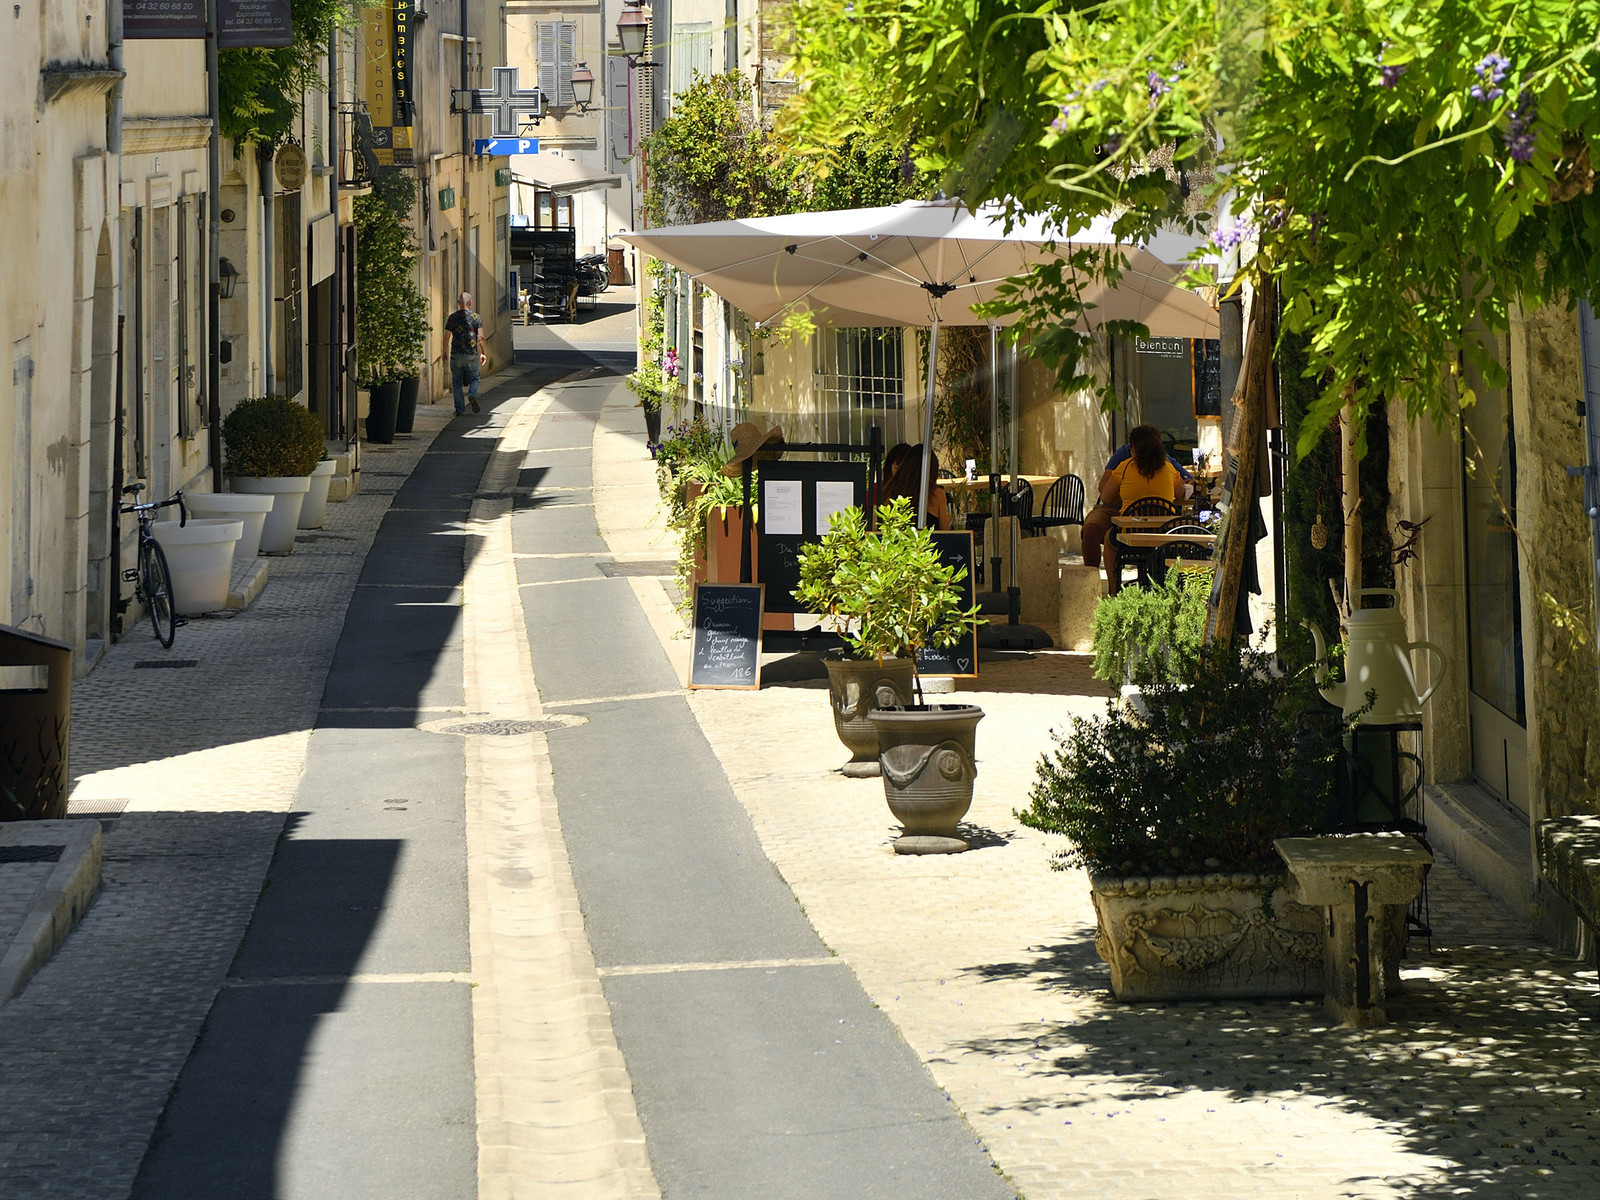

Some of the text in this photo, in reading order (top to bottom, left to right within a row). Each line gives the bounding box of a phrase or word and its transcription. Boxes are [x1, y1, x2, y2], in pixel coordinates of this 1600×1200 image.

[136, 2, 146, 10] 04
[147, 2, 158, 10] 32
[183, 2, 194, 10] 20
[518, 140, 531, 154] P
[702, 592, 752, 612] Suggestion
